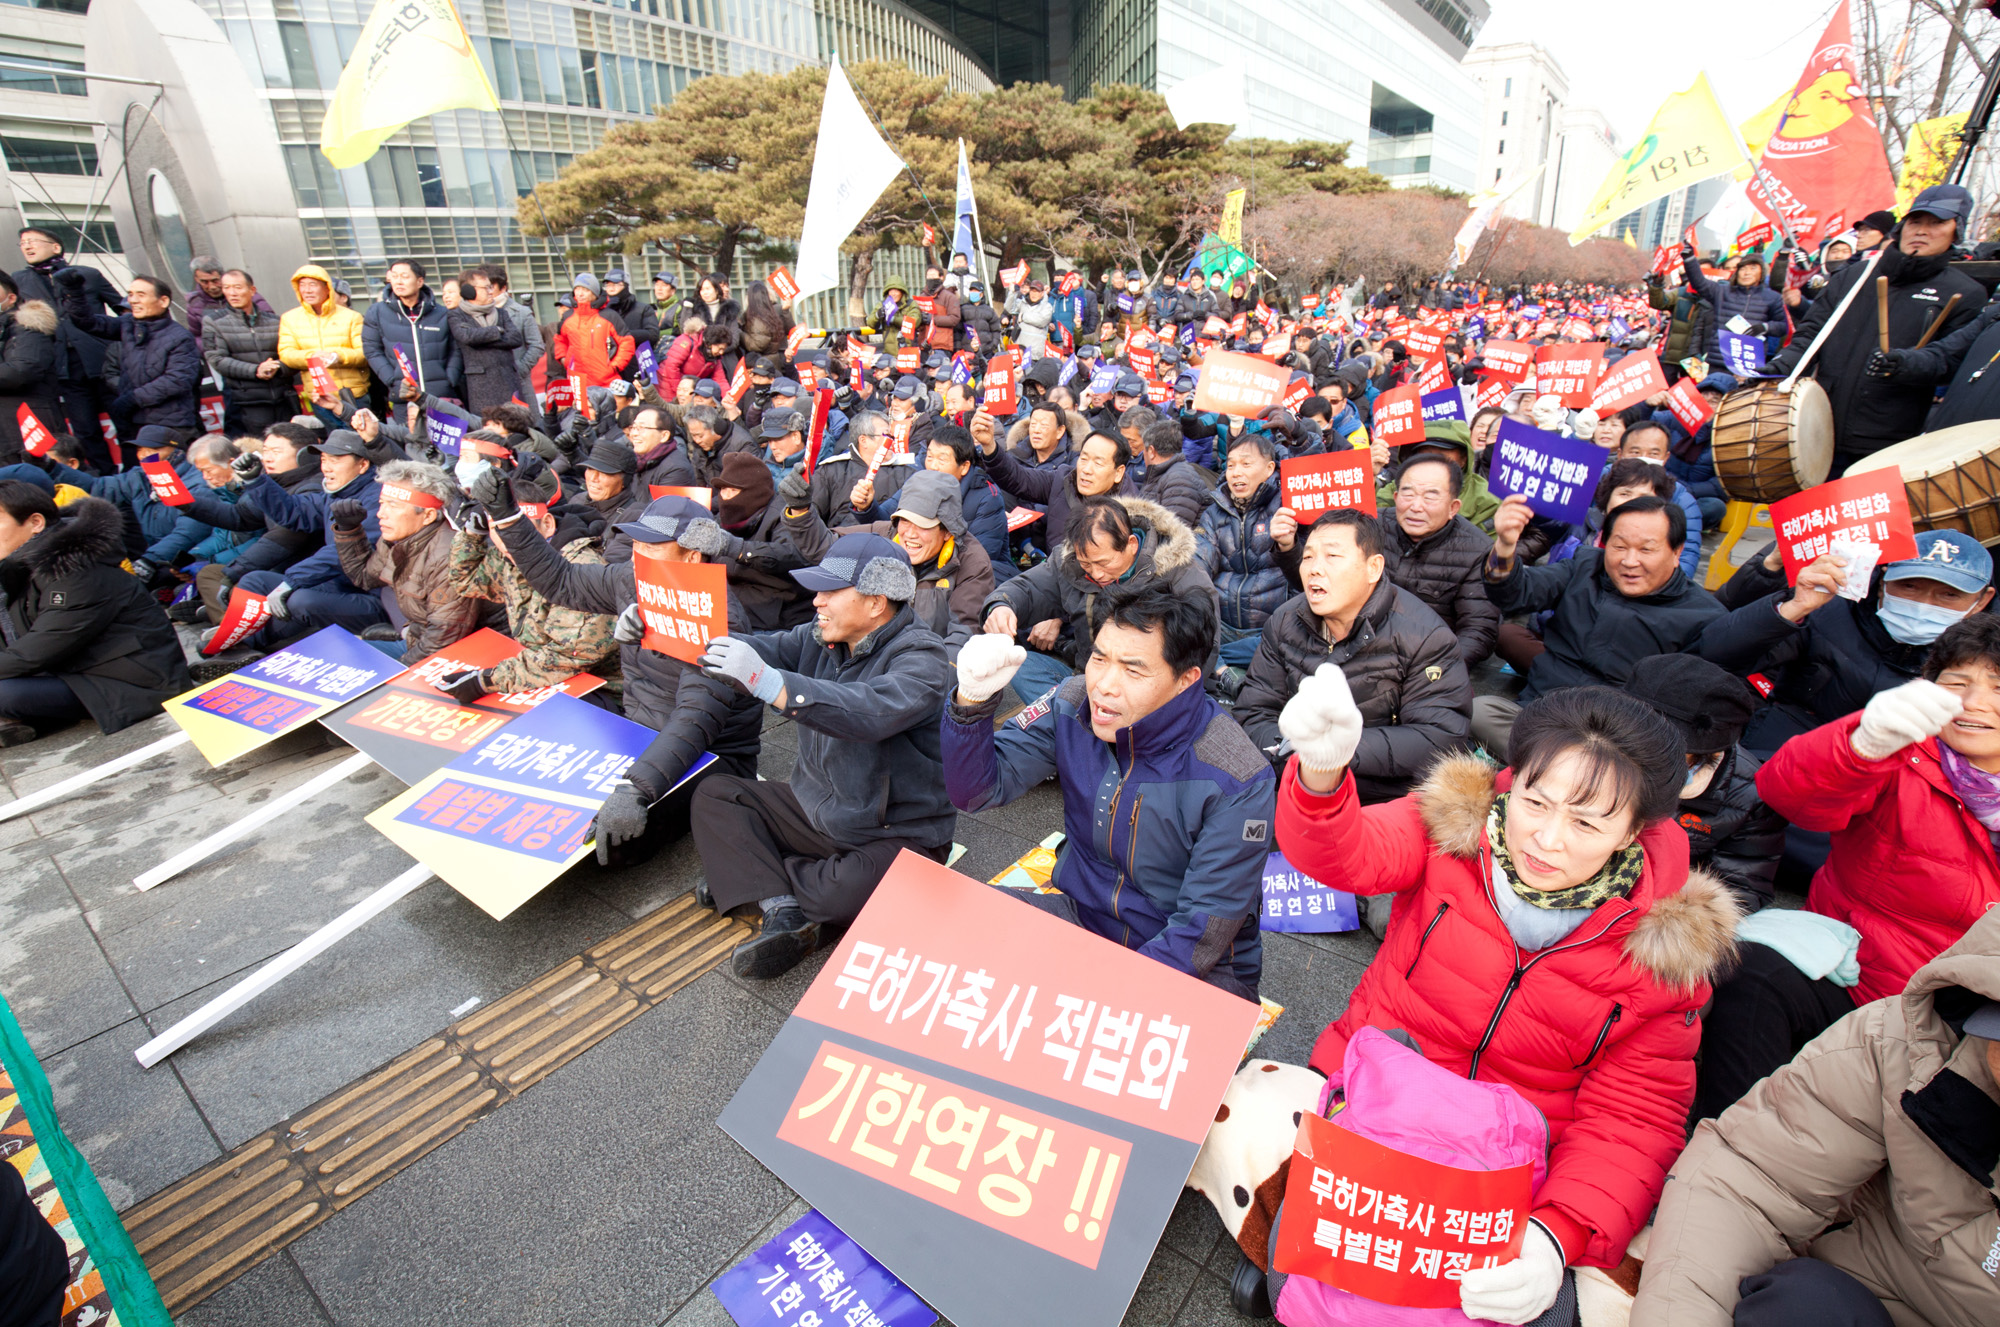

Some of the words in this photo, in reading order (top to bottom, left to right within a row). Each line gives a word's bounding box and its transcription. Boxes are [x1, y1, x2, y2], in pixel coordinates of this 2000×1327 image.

[1287, 472, 1331, 492] 무허가축사
[1333, 467, 1364, 486] 적법화
[1500, 439, 1548, 475] 무허가축사
[1550, 457, 1588, 486] 적법화
[1291, 494, 1325, 511] 특별법
[1328, 490, 1351, 507] 제정
[1782, 505, 1838, 541] 무허가축사
[1840, 492, 1890, 520] 적법화
[1792, 534, 1829, 562] 특별법
[1876, 521, 1889, 540] !!
[637, 579, 678, 612] 무허가축사
[678, 588, 713, 618] 적법화
[644, 609, 677, 638] 특별법
[676, 618, 700, 645] 제정
[252, 651, 337, 686] 무허가축사
[314, 663, 378, 696] 적법화
[197, 682, 267, 715] 특별법
[242, 694, 302, 726] 제정
[361, 694, 482, 742] 기한연장
[460, 718, 504, 746] !!
[473, 733, 598, 784] 무허가축사
[582, 752, 637, 793] 적법
[414, 781, 516, 834] 특별법
[491, 801, 581, 849] 제정
[1303, 873, 1327, 889] 적
[833, 940, 1038, 1062] 무허가축사
[1042, 992, 1191, 1111] 적법화
[798, 1054, 1057, 1218] 기한연장
[1063, 1146, 1121, 1242] !!
[1309, 1166, 1435, 1237] 무허가축사
[1442, 1208, 1514, 1245] 적법화
[785, 1231, 857, 1313] 무허가축사
[1313, 1218, 1402, 1273] 특별법
[1410, 1246, 1473, 1280] 제정
